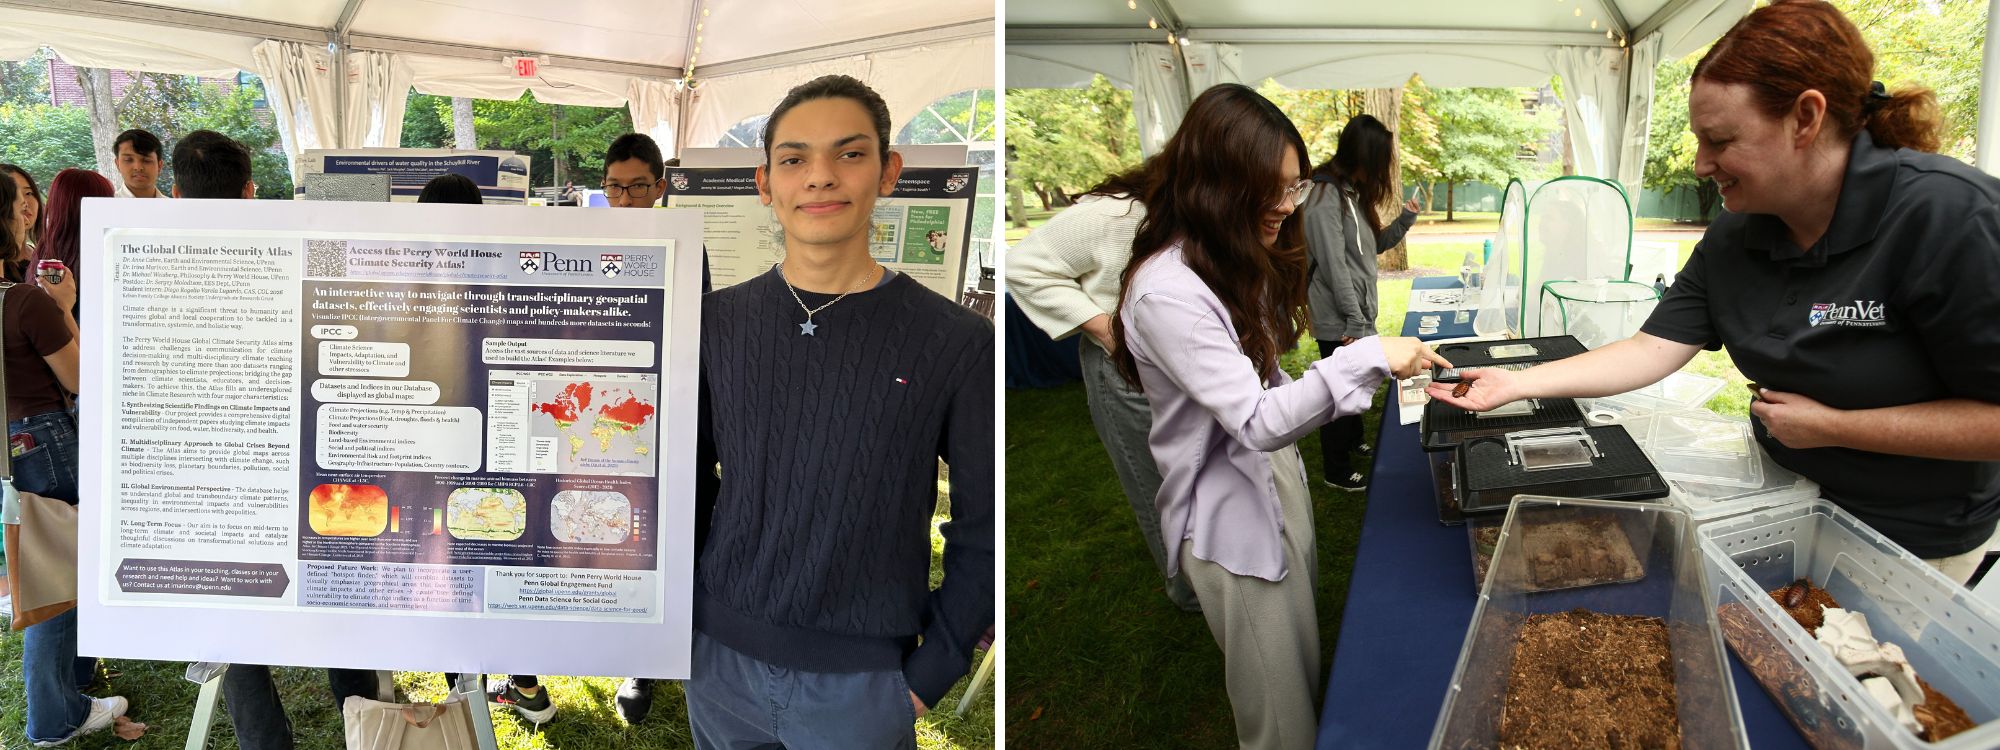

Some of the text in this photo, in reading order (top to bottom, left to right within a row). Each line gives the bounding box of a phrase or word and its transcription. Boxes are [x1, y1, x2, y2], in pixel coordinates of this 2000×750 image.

[518, 60, 534, 76] EXIT
[121, 244, 292, 258] The Global Climate Security Atlas
[350, 246, 502, 258] Access the Perry World House
[350, 258, 465, 270] Climate Security Atlas!
[542, 252, 593, 272] Penn
[313, 288, 648, 305] An interactive way to navigate through transdisciplinary geospatial
[312, 300, 631, 317] datasets, effectively engaging scientists and policy-makers alike.
